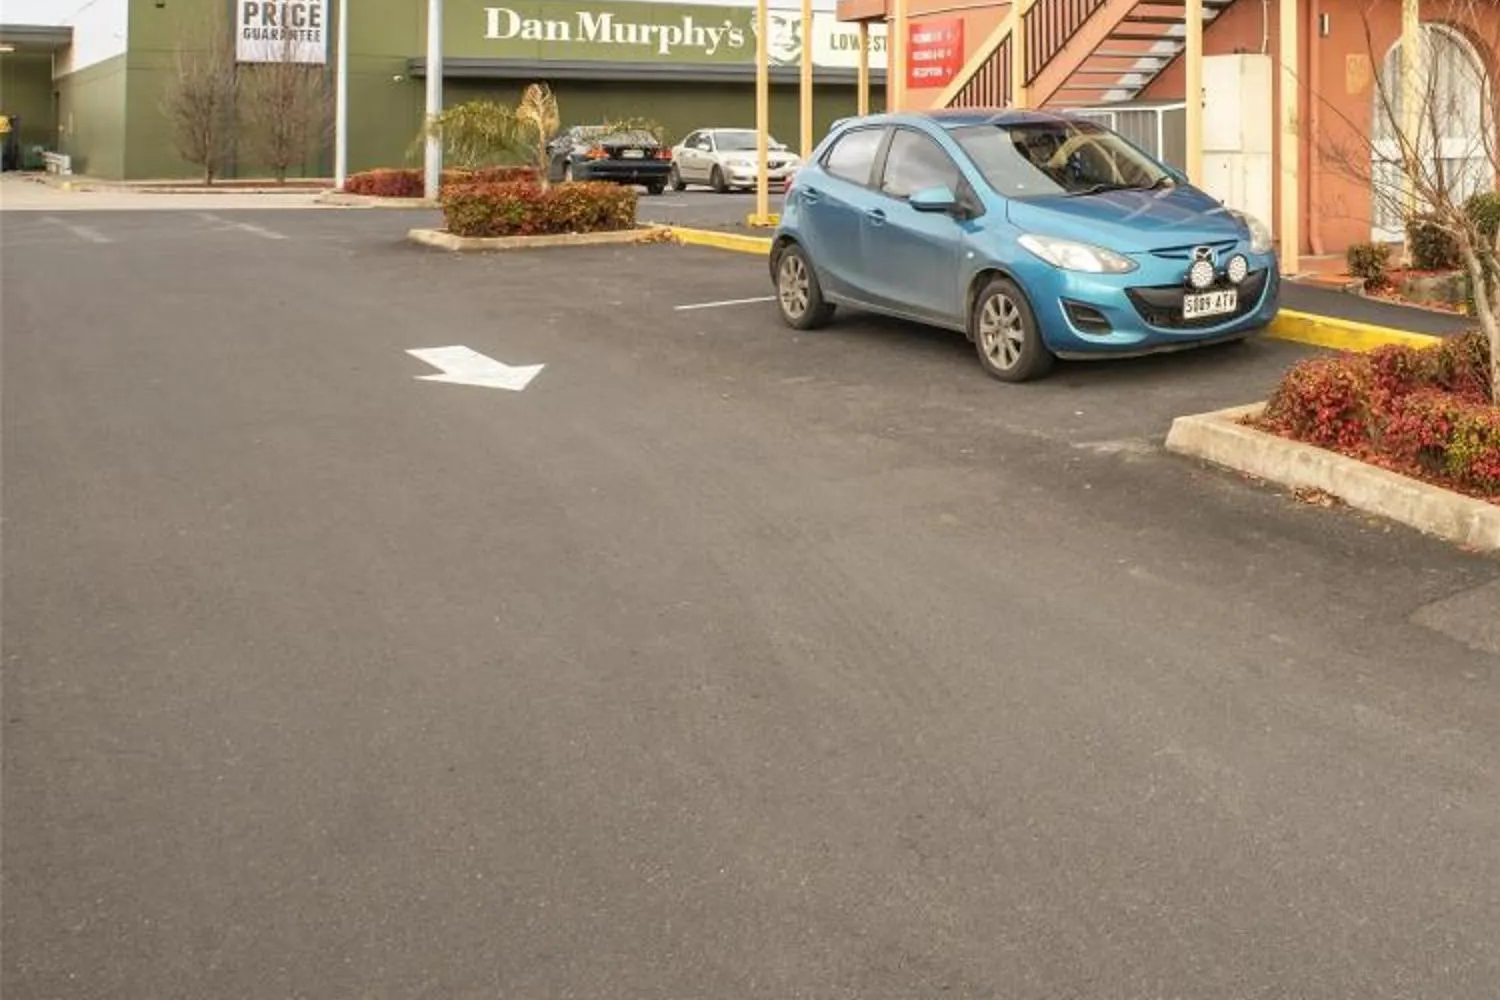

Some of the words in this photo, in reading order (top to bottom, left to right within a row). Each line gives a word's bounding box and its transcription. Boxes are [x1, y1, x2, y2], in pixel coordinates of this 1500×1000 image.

[243, 2, 321, 28] PRICE
[243, 28, 321, 41] GUARANTEE
[484, 7, 570, 41] Dan
[575, 11, 745, 55] Murphy's
